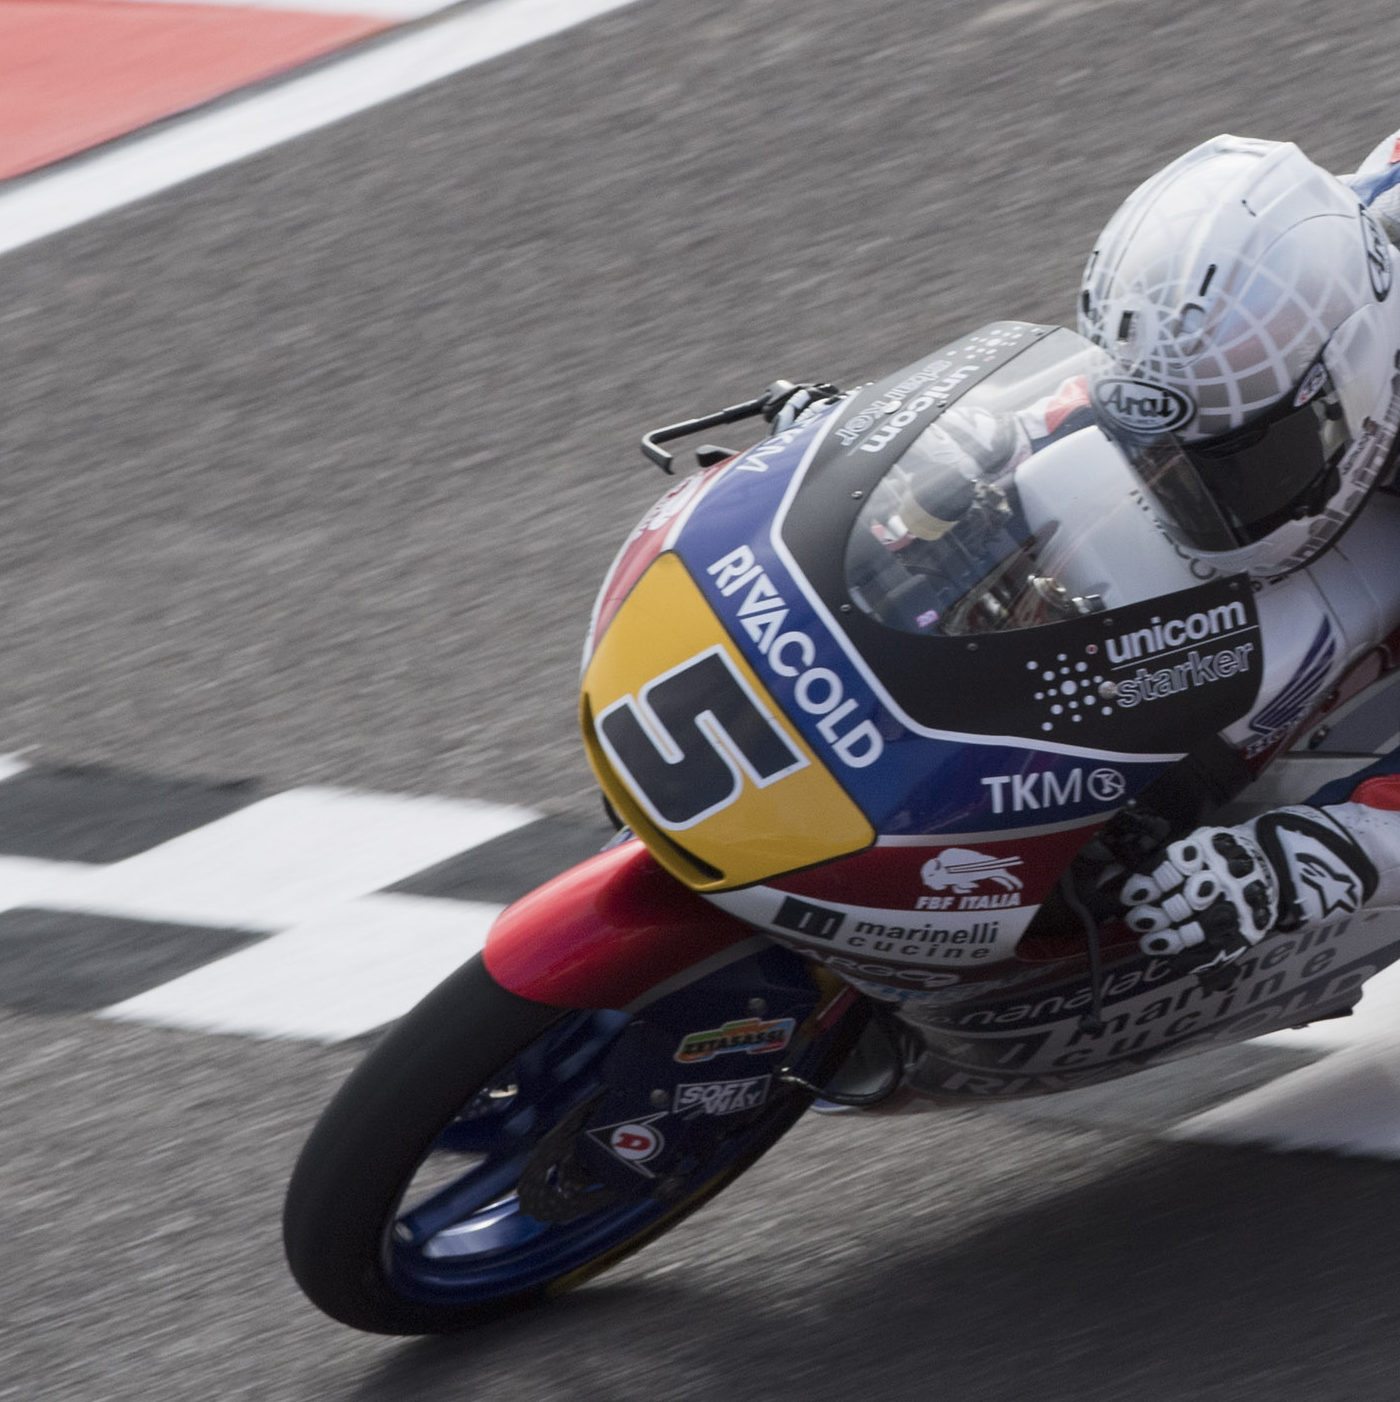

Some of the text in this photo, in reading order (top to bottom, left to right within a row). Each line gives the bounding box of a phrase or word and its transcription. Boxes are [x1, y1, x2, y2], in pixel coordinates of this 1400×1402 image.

[860, 365, 979, 452] unicom
[1101, 384, 1176, 418] Arai
[1105, 601, 1247, 663] unicom
[707, 545, 884, 768] RIVACOLD
[1117, 643, 1254, 708] starker
[594, 643, 811, 831] 5
[981, 768, 1083, 814] TKM
[914, 893, 1021, 910] FBF ITALIA
[847, 936, 991, 959] cucine
[854, 920, 1000, 945] marinelli
[1053, 947, 1337, 1067] cucine
[680, 1080, 757, 1104] SOFT
[702, 1091, 761, 1116] WAY
